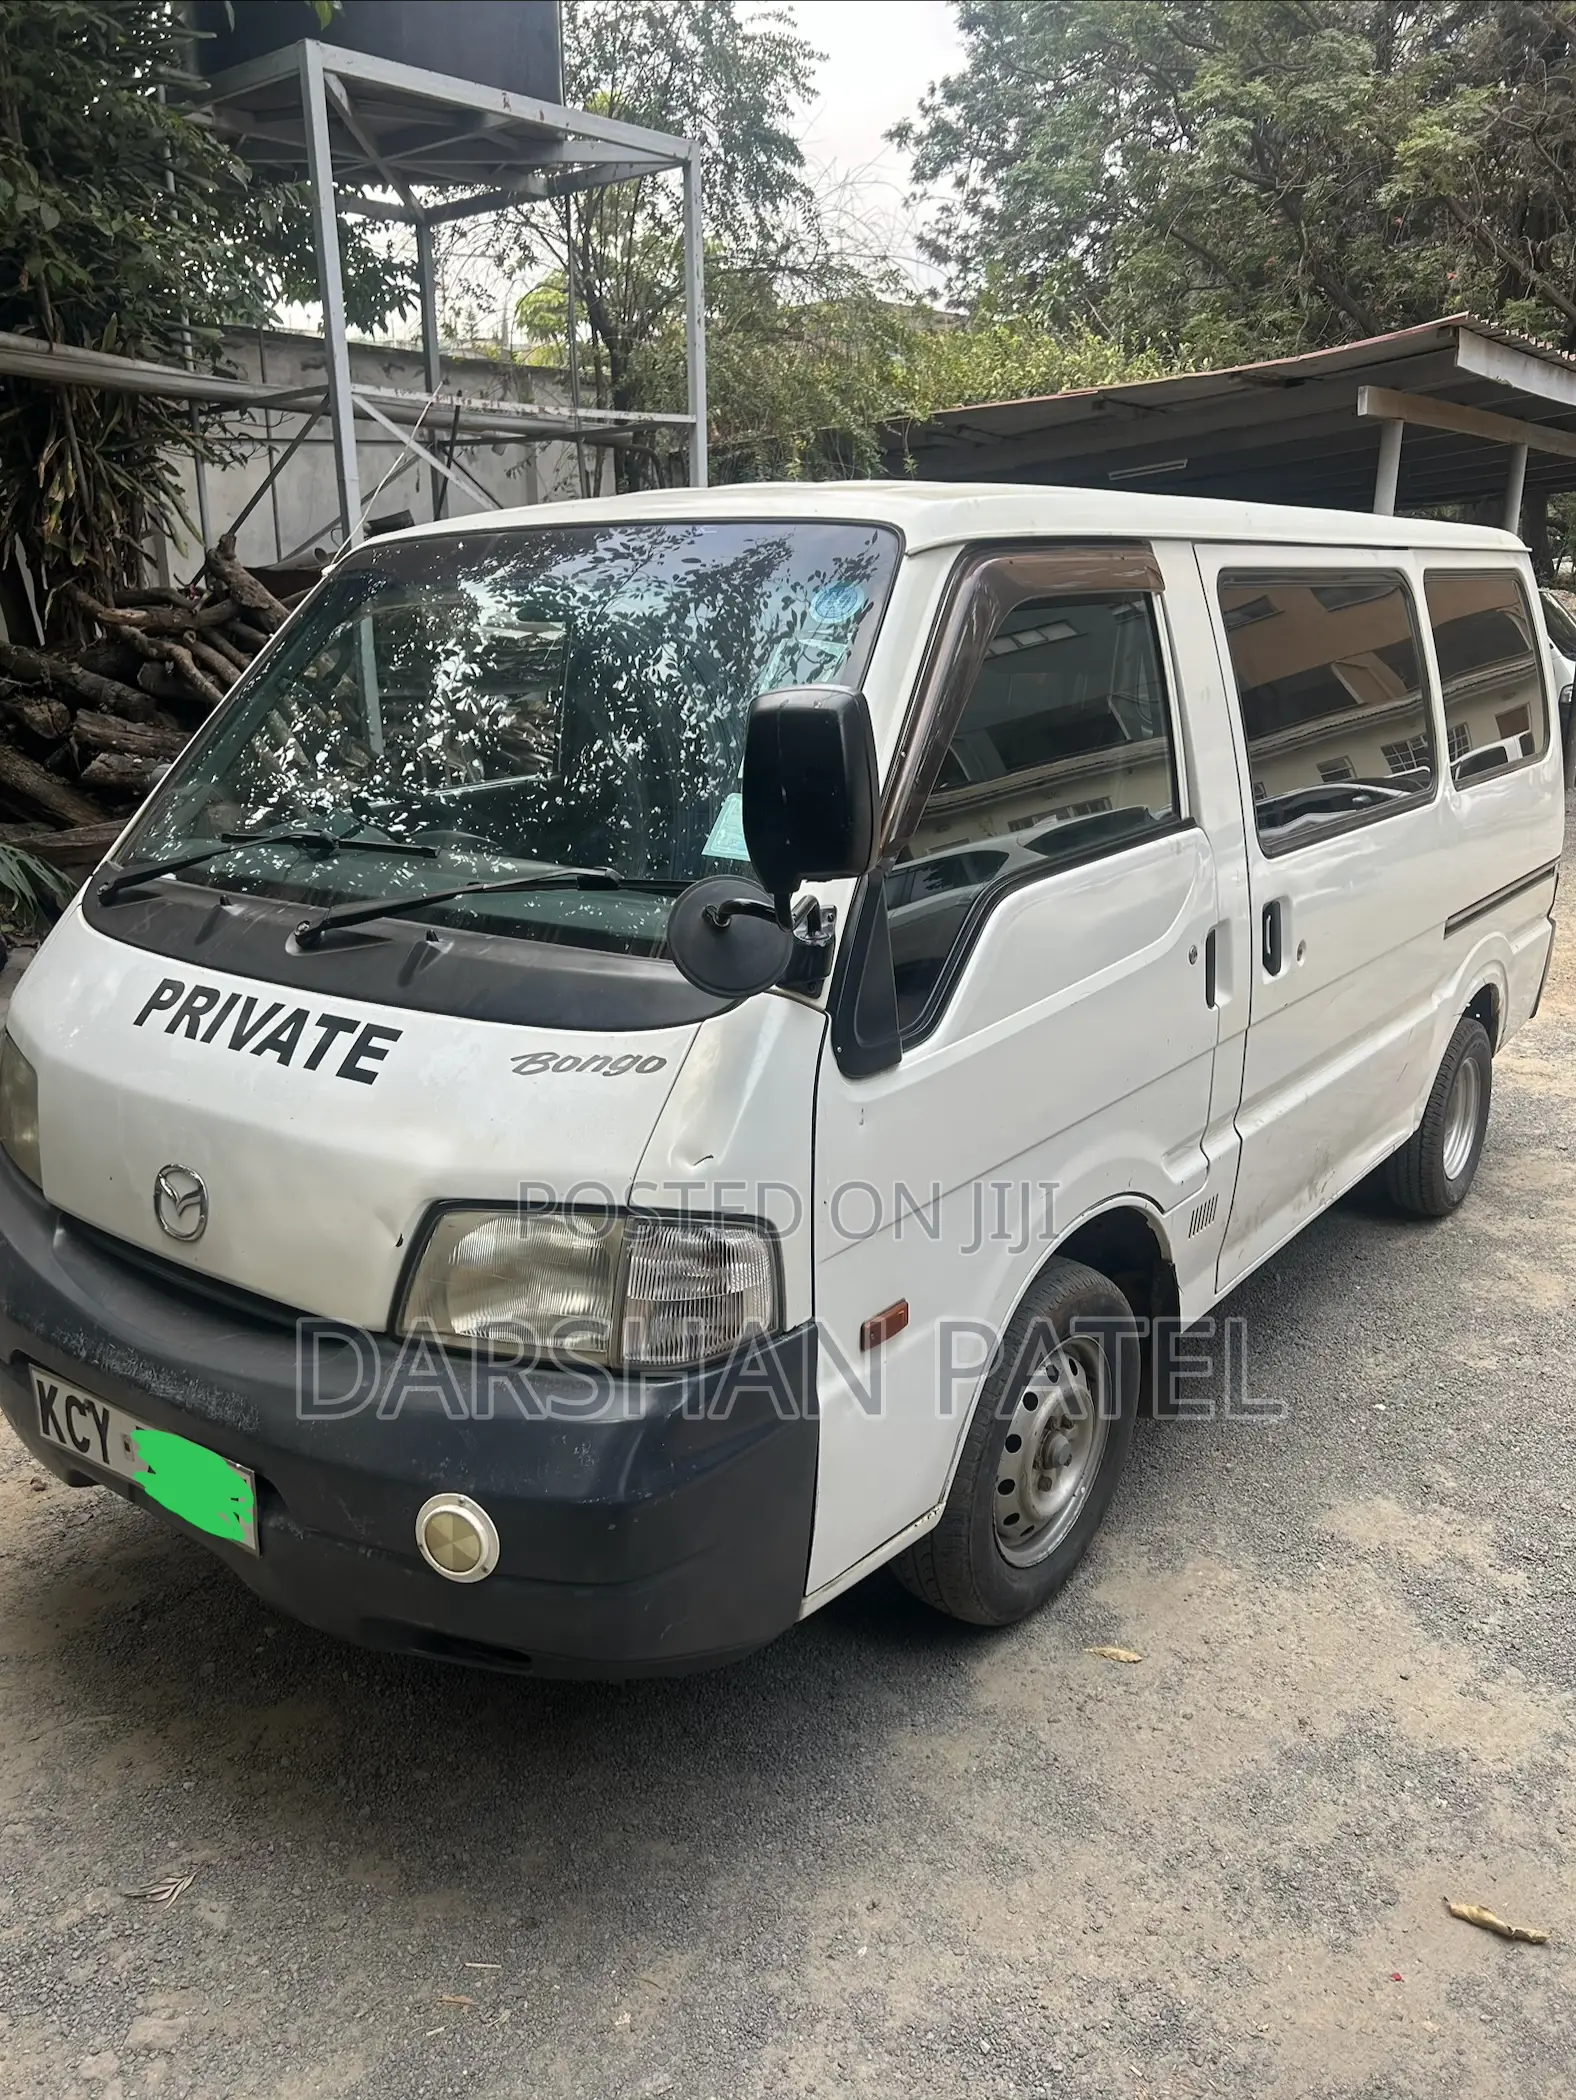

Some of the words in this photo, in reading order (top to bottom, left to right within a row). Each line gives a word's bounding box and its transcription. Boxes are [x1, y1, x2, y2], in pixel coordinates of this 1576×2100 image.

[133, 978, 403, 1085] PRIVATE
[510, 1050, 668, 1078] Bongo
[36, 1379, 111, 1465] KCY
